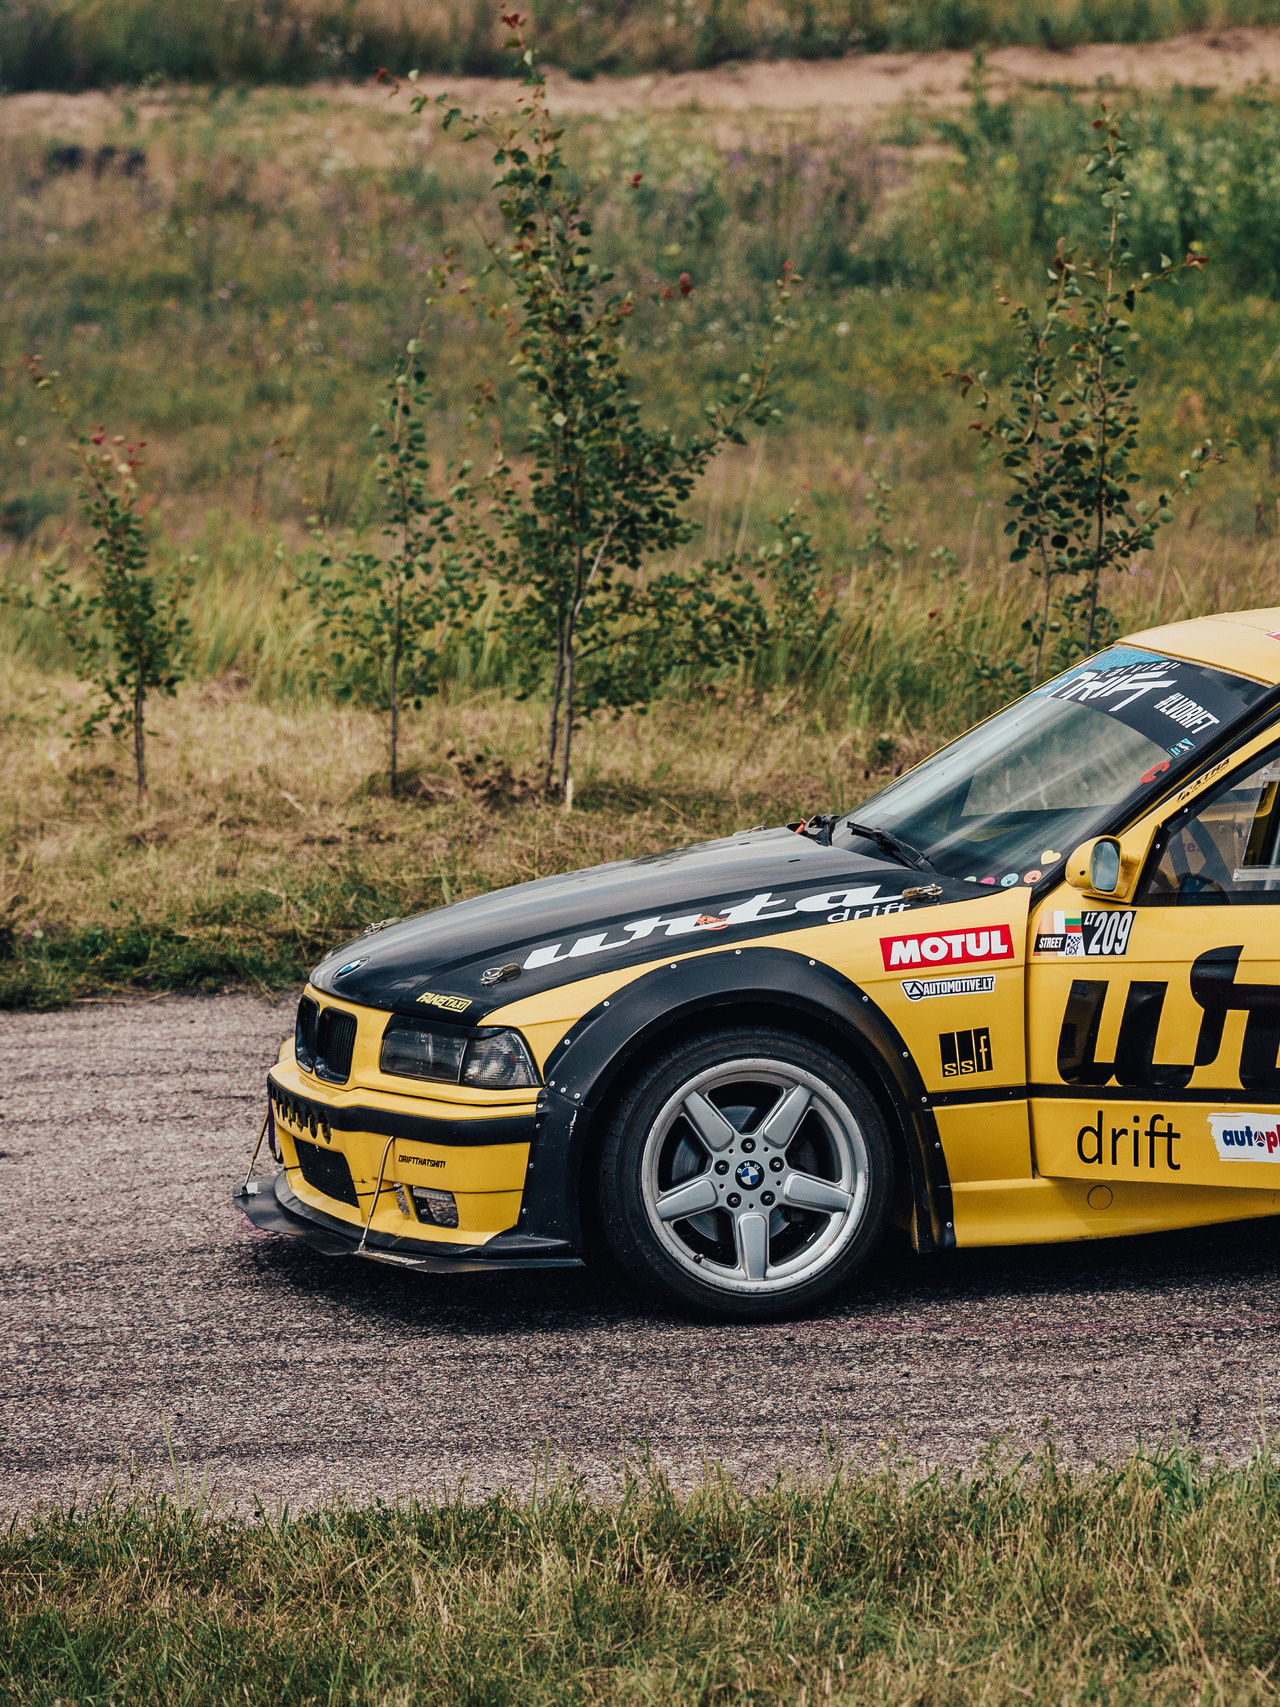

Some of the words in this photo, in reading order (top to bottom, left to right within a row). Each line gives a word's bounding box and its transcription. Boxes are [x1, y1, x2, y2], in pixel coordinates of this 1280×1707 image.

[1153, 692, 1220, 734] #LVDRIFT
[827, 902, 911, 923] drift
[1083, 912, 1098, 926] LT
[1039, 936, 1063, 949] STREET
[1087, 911, 1133, 955] 209
[889, 930, 1008, 966] MOTUL
[923, 977, 994, 996] AUTOMOTIVE.LT
[1076, 1110, 1181, 1170] drift
